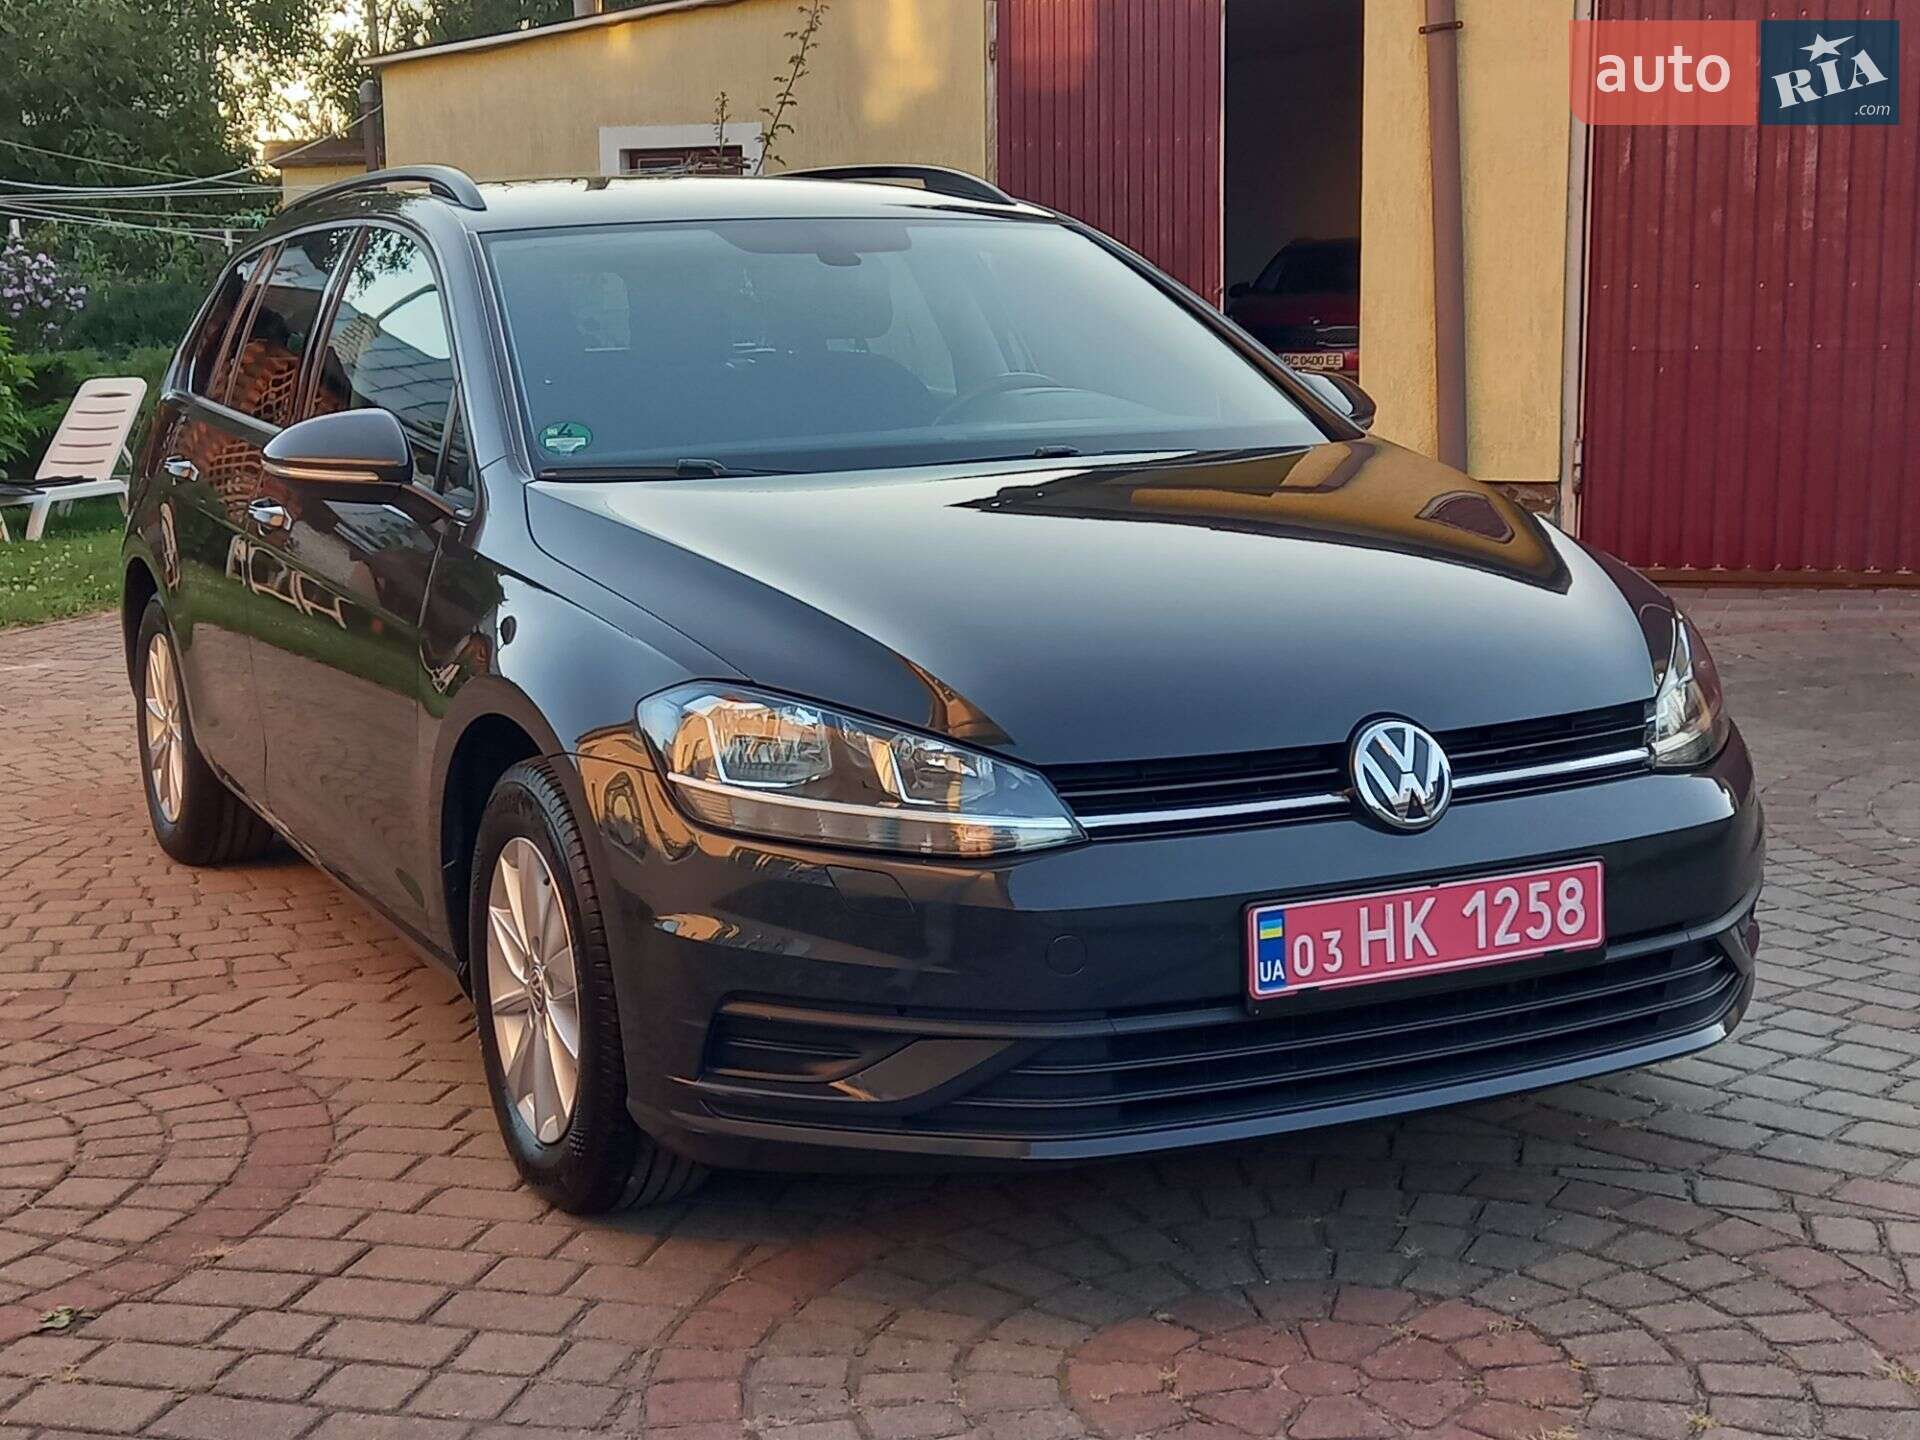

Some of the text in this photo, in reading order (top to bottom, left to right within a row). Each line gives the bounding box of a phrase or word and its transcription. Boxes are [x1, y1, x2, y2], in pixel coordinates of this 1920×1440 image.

[1326, 354, 1341, 366] EE
[1292, 876, 1586, 978] 03 HK 1258
[1259, 960, 1286, 983] UA
